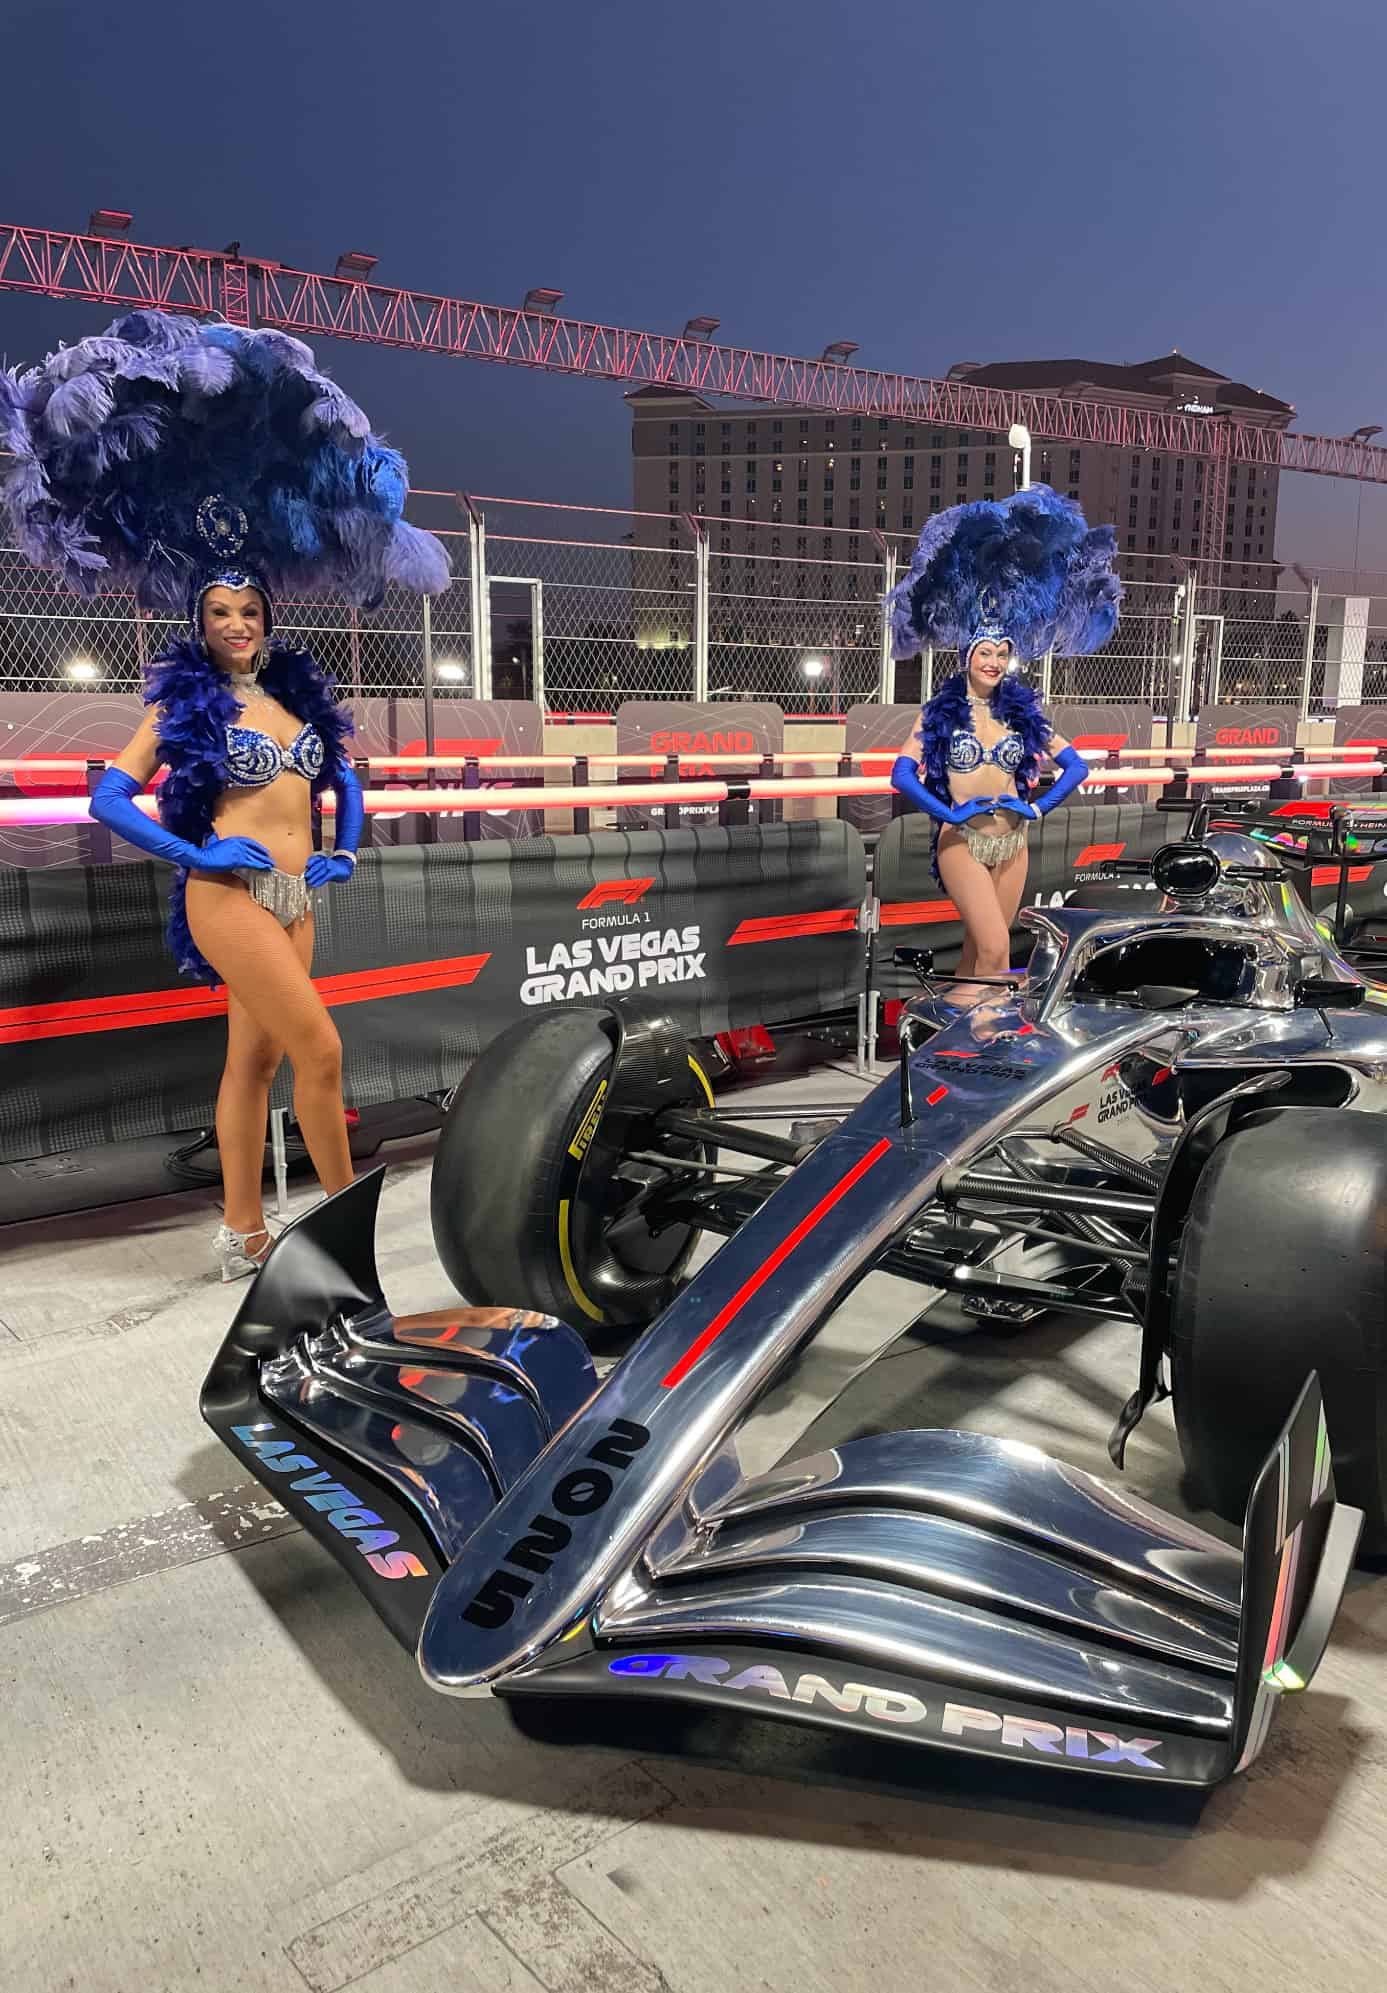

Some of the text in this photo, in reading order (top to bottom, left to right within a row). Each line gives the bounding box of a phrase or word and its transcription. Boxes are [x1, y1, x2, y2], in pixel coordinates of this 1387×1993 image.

[650, 730, 754, 753] GRAND
[1215, 727, 1279, 745] GRAND
[1034, 889, 1079, 908] LA
[582, 911, 651, 930] FORMULA 1
[526, 925, 701, 975] LAS VEGAS
[519, 953, 707, 1006] GRAND PRIX
[1100, 1091, 1118, 1109] LAS
[1097, 1100, 1129, 1124] GRAND
[230, 1423, 429, 1579] LAS VEGAS
[607, 1654, 1167, 1770] GRAND PRIX
